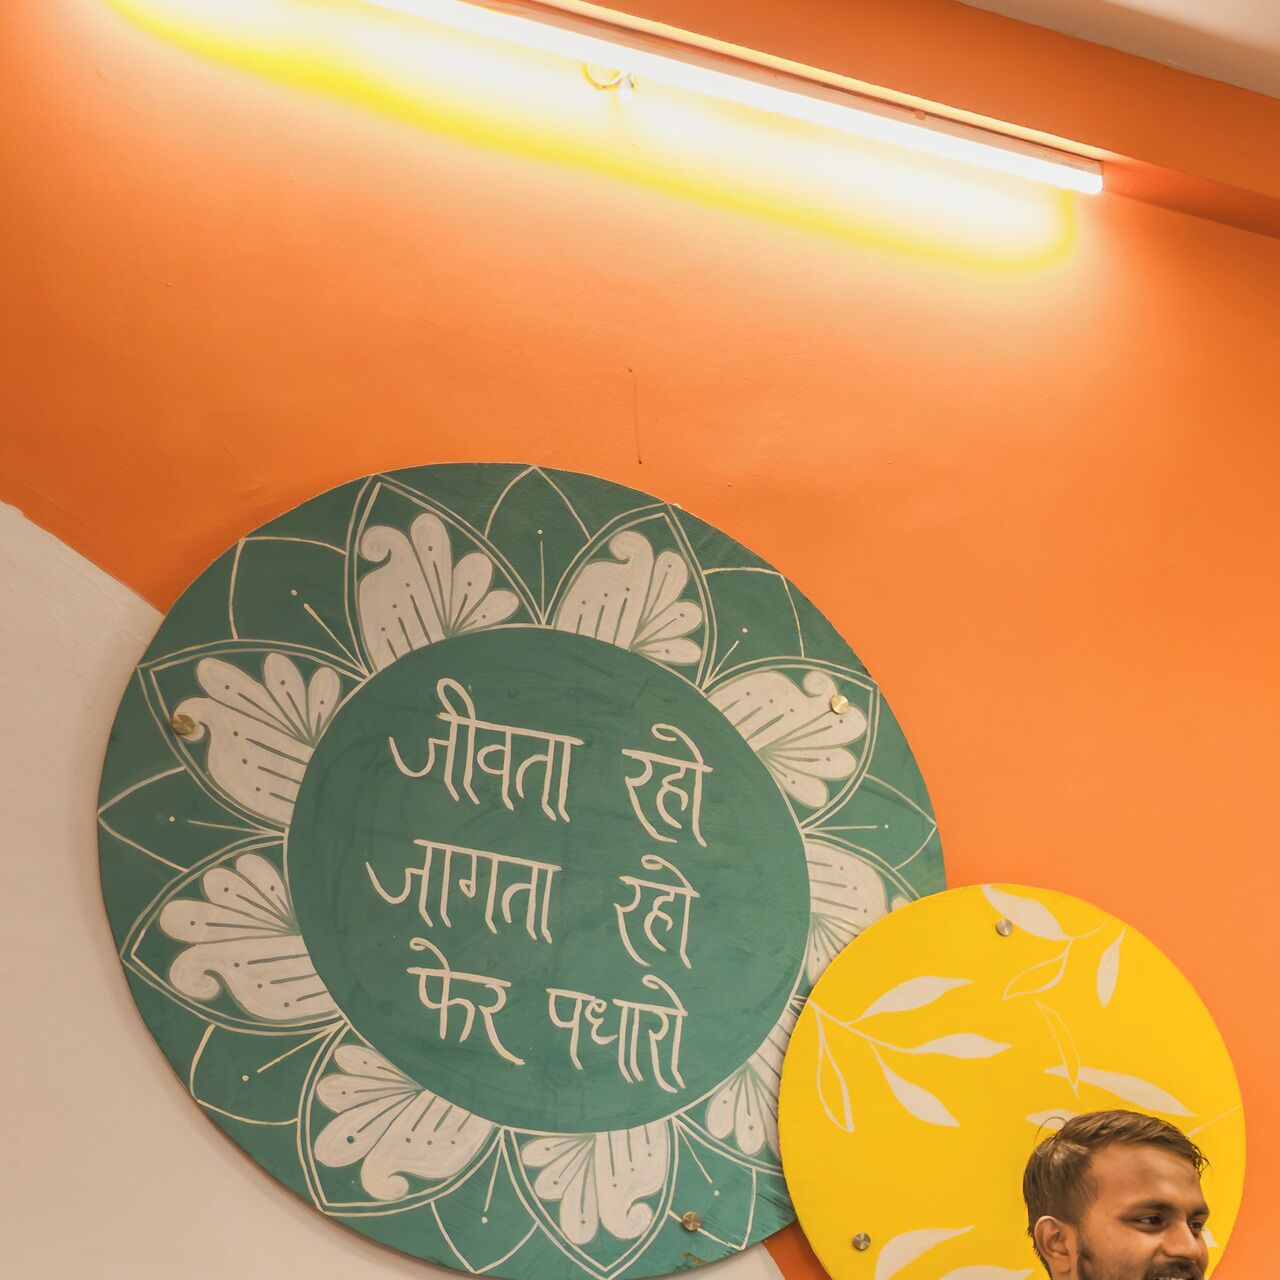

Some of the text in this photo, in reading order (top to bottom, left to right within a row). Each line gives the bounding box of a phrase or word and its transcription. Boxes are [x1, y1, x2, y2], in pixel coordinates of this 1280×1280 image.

[389, 676, 714, 848] जीवता रहो
[367, 839, 702, 970] जागता रहो
[408, 937, 689, 1094] फेर पधारो
